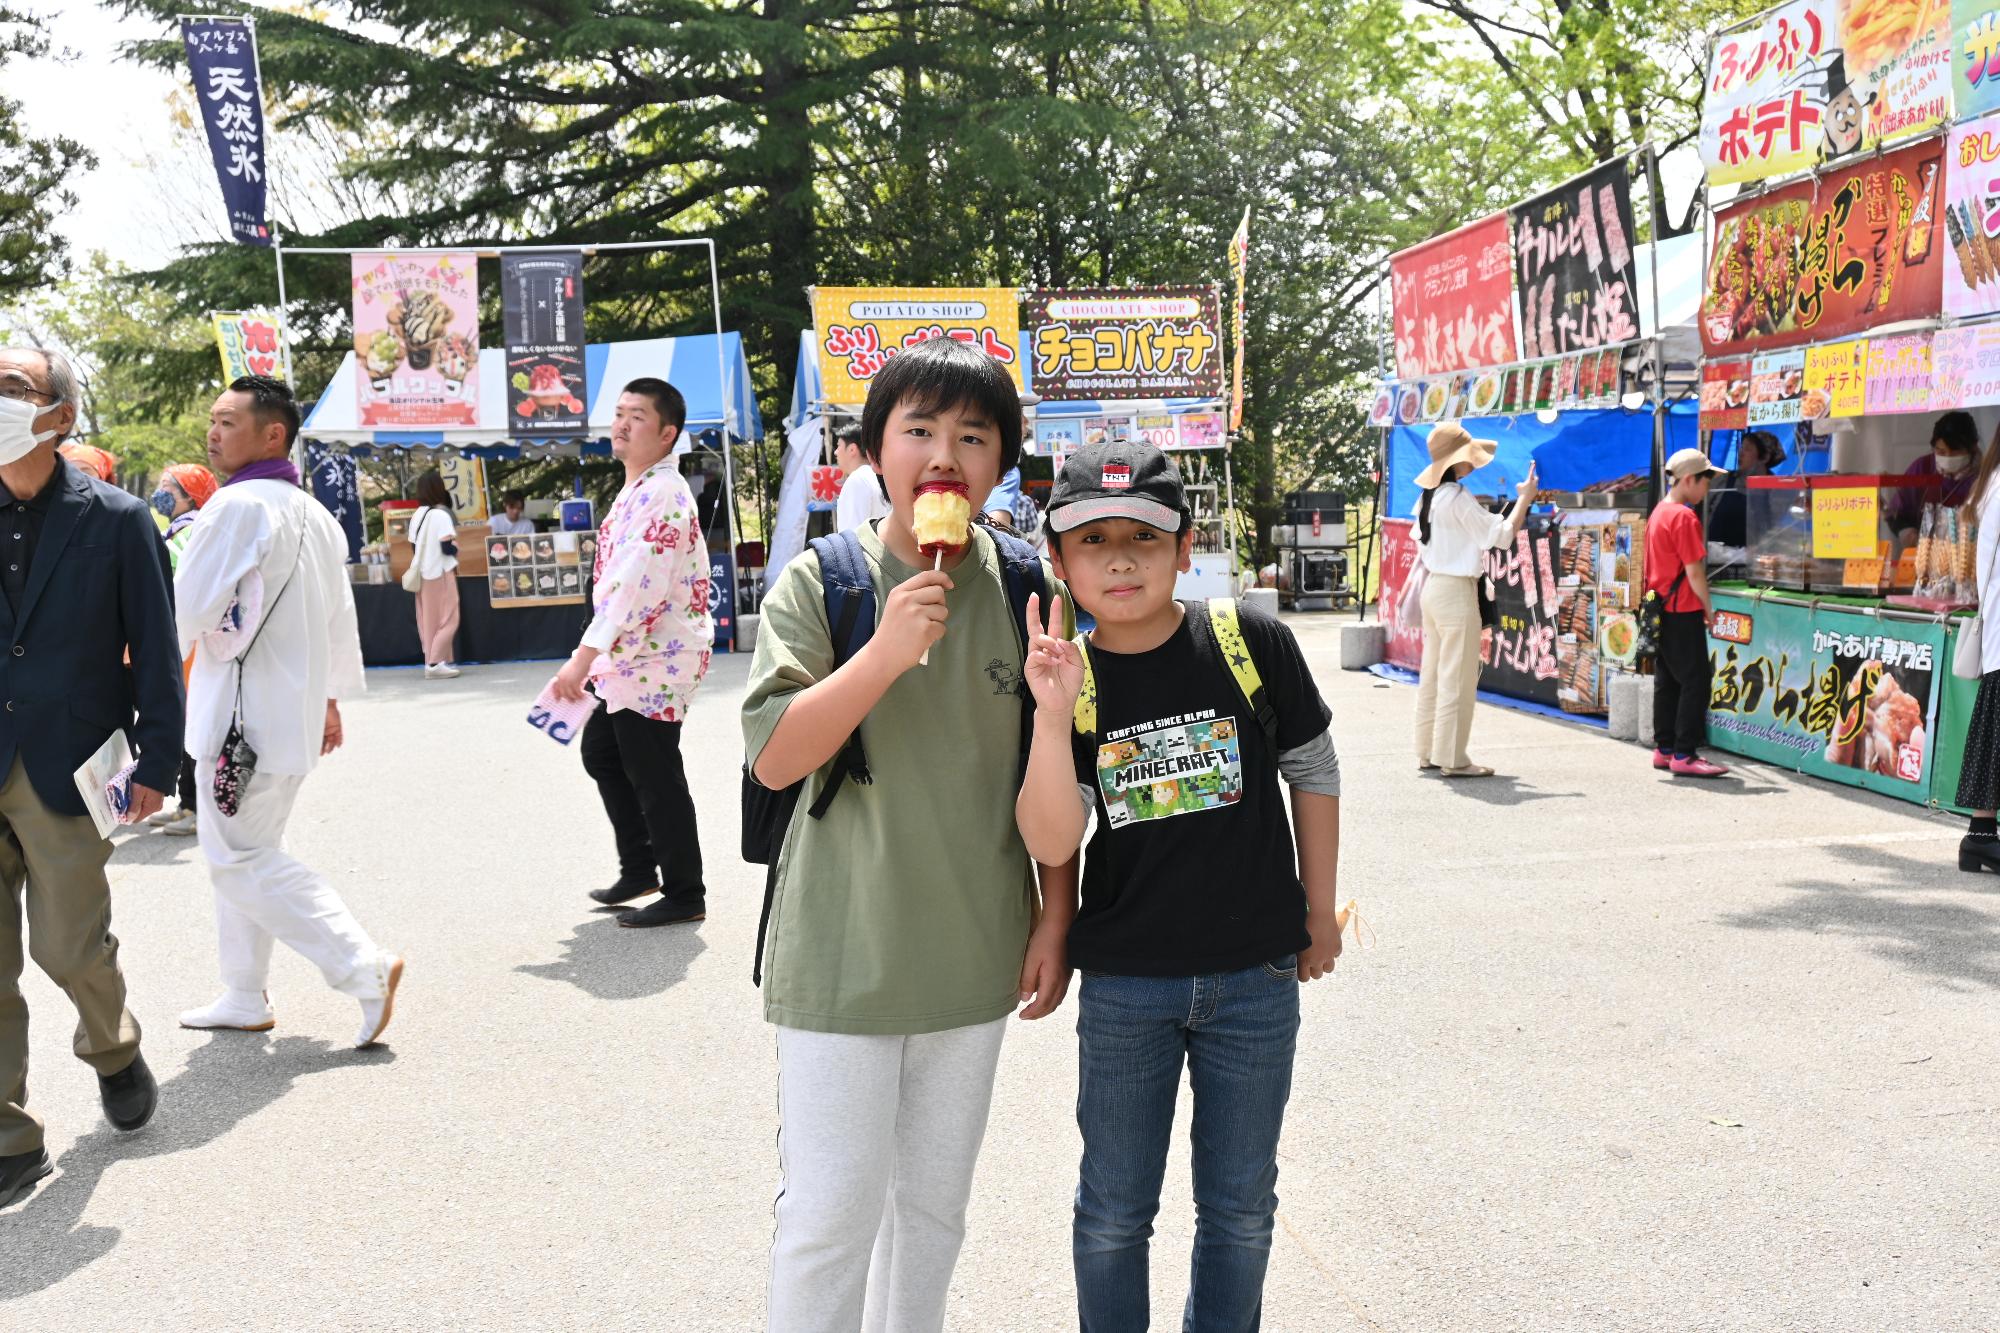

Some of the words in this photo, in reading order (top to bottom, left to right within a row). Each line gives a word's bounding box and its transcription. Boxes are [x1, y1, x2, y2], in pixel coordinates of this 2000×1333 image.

[1713, 8, 1822, 93] ふりふり
[206, 66, 262, 184] 天然氷
[1718, 90, 1820, 165] ポテト
[1517, 215, 1584, 283] 牛カルビ
[863, 305, 926, 317] POTATO
[932, 304, 974, 316] SHOP
[1062, 305, 1142, 315] CHOCOLATE
[1150, 303, 1186, 313] SHOP
[826, 325, 877, 354] ふり
[1037, 321, 1216, 376] チョコバナナ
[1810, 351, 1849, 370] ふりふり
[1066, 377, 1137, 389] CHOCOLATE
[1140, 376, 1190, 387] BANANA
[1824, 370, 1863, 392] ポテト
[811, 465, 844, 502] 氷
[1816, 495, 1873, 512] ふりふりポテト
[1812, 628, 1934, 672] からあげ専門店
[1107, 721, 1154, 741] CRAFTING
[1155, 715, 1182, 730] SINCE
[1184, 708, 1216, 723] ALPHA
[1115, 748, 1230, 788] MINECRAFT
